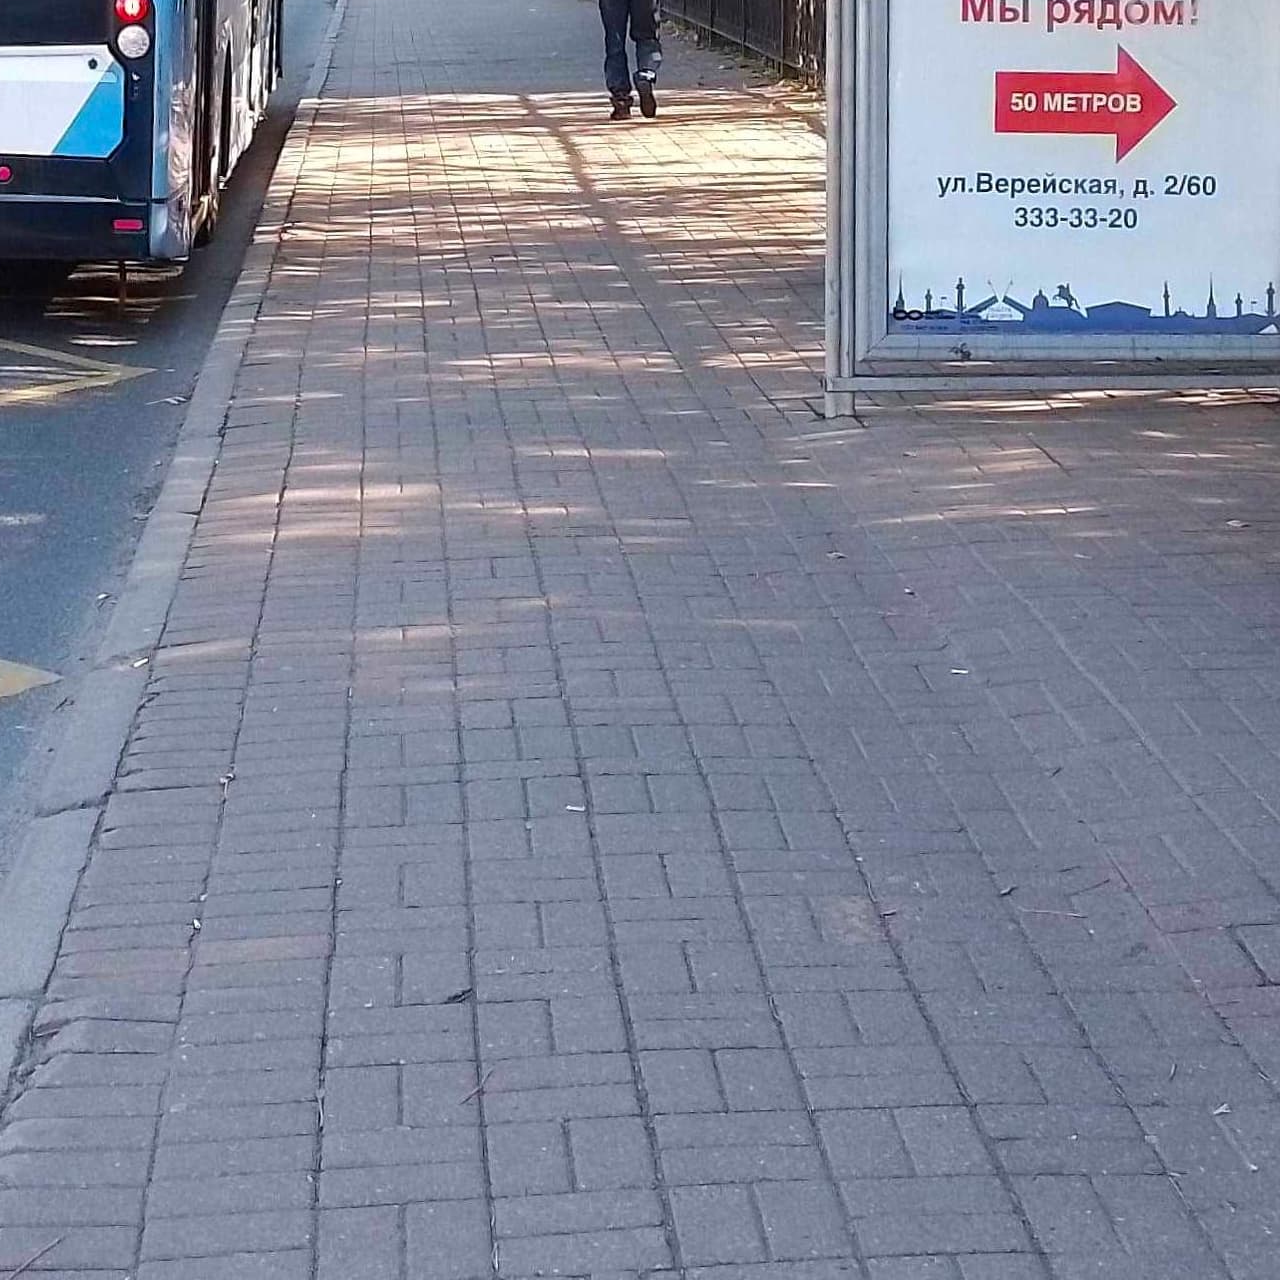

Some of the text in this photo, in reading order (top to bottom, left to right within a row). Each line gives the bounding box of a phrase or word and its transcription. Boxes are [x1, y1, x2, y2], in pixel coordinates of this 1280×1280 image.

[1010, 92, 1142, 113] 50 МЕТРОВ
[1133, 177, 1155, 199] д.
[1164, 174, 1217, 196] 2/60
[1014, 206, 1138, 229] 333-33-20
